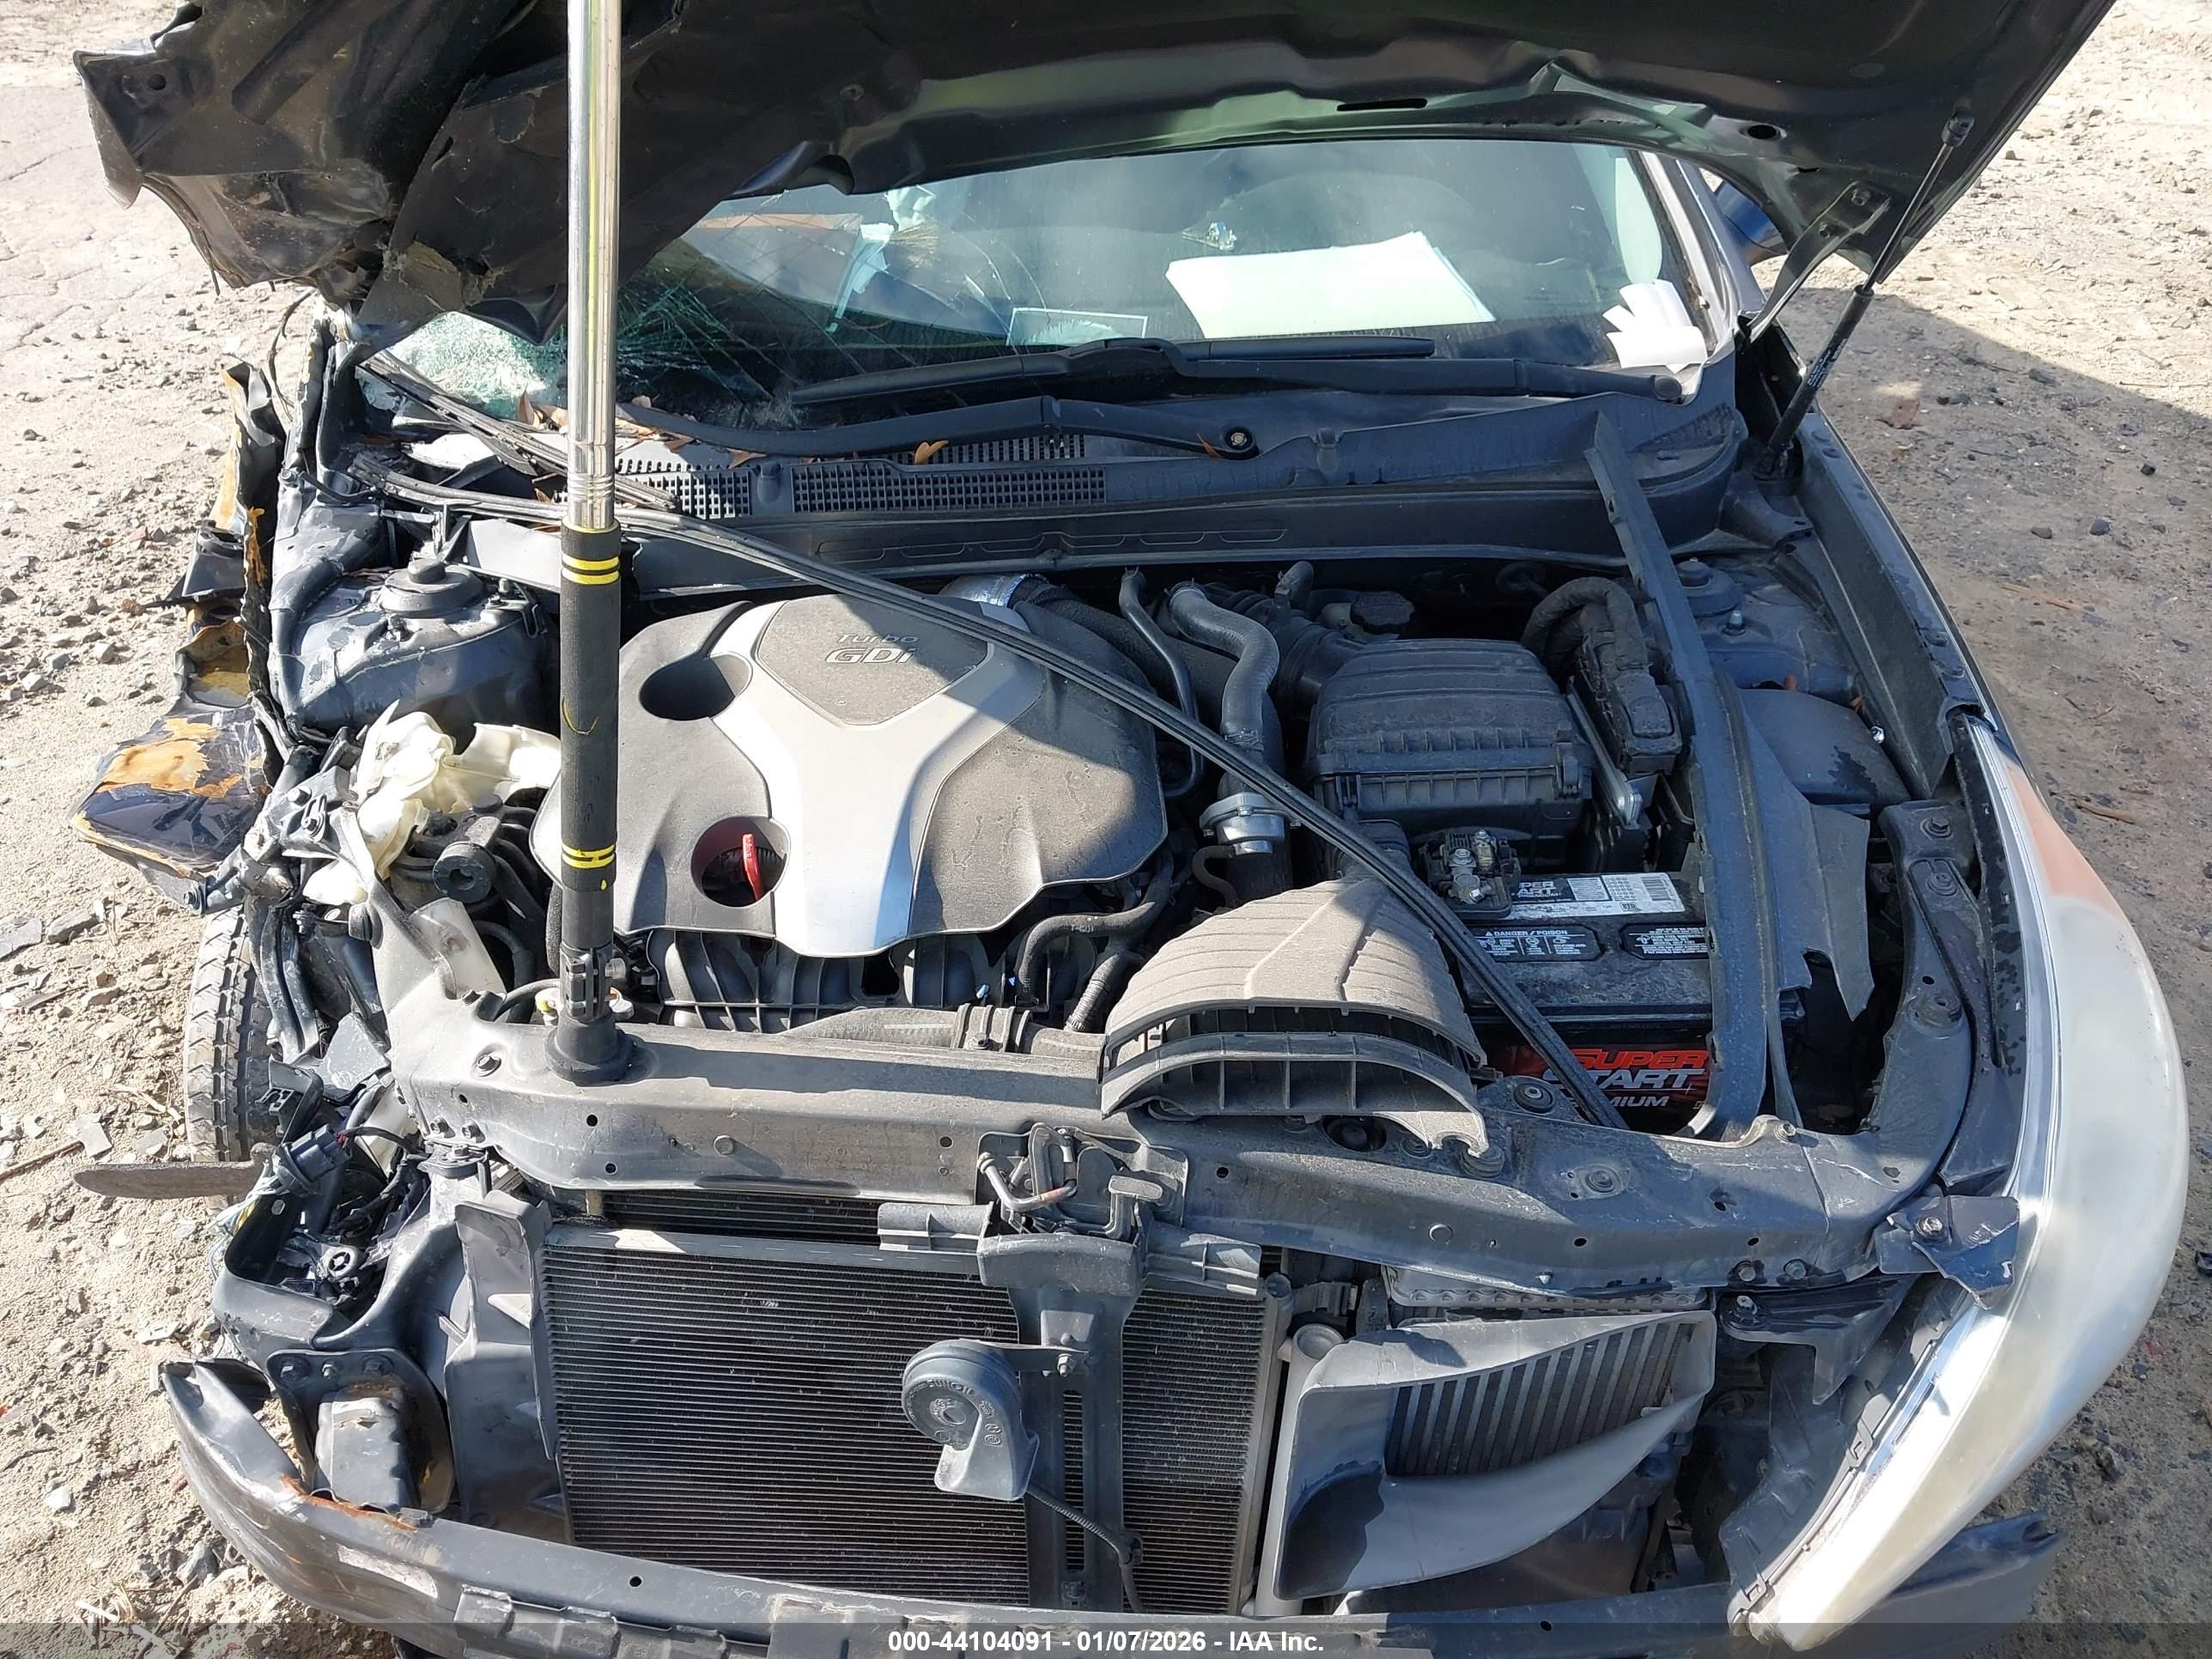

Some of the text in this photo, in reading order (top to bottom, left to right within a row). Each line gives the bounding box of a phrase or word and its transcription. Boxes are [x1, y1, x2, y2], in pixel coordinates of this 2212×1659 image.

[837, 634, 920, 643] Turbo
[825, 647, 918, 664] GDi
[1571, 1048, 1709, 1069] SUPER
